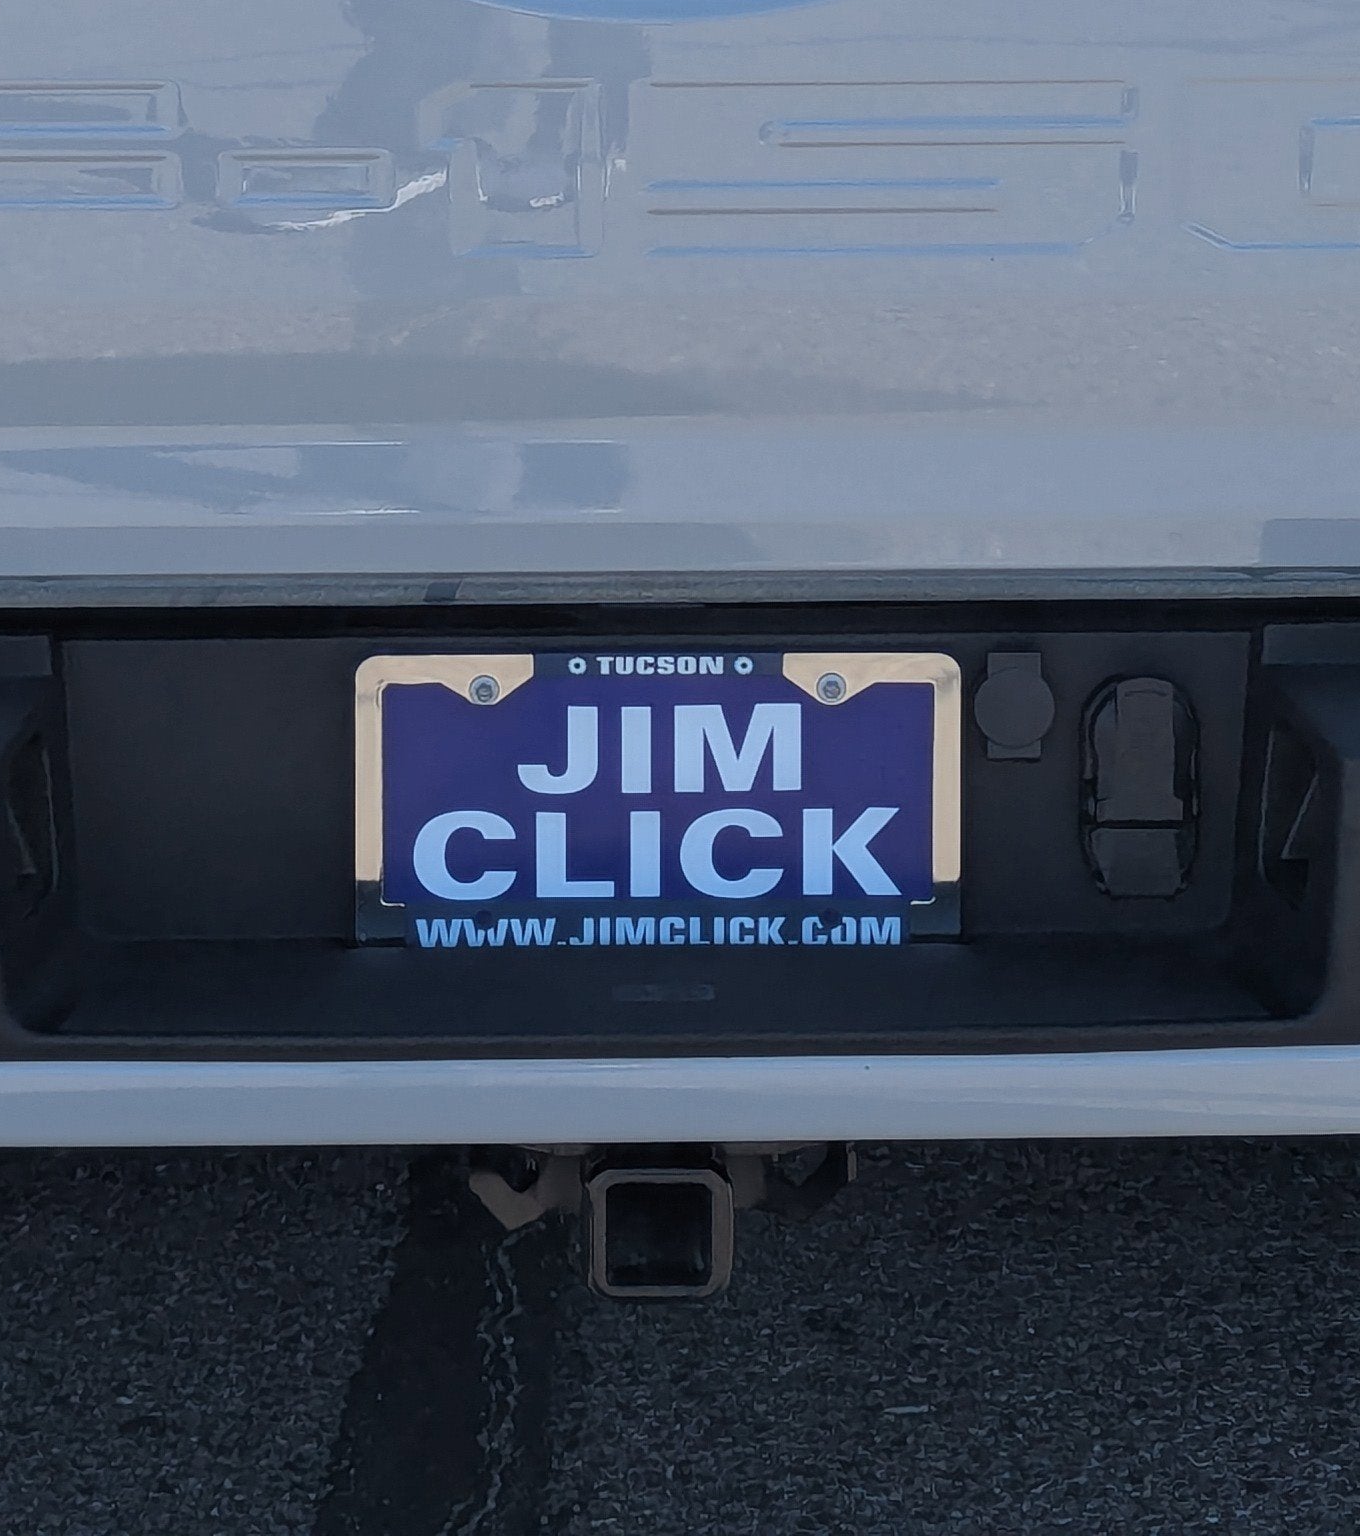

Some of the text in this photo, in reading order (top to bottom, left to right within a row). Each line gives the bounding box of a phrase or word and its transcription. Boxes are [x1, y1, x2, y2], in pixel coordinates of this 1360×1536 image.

[596, 655, 725, 675] TUCSON
[517, 702, 802, 795] JIM
[412, 806, 903, 901] CLICK
[414, 915, 903, 948] WWW.JIMCLICK.COM
